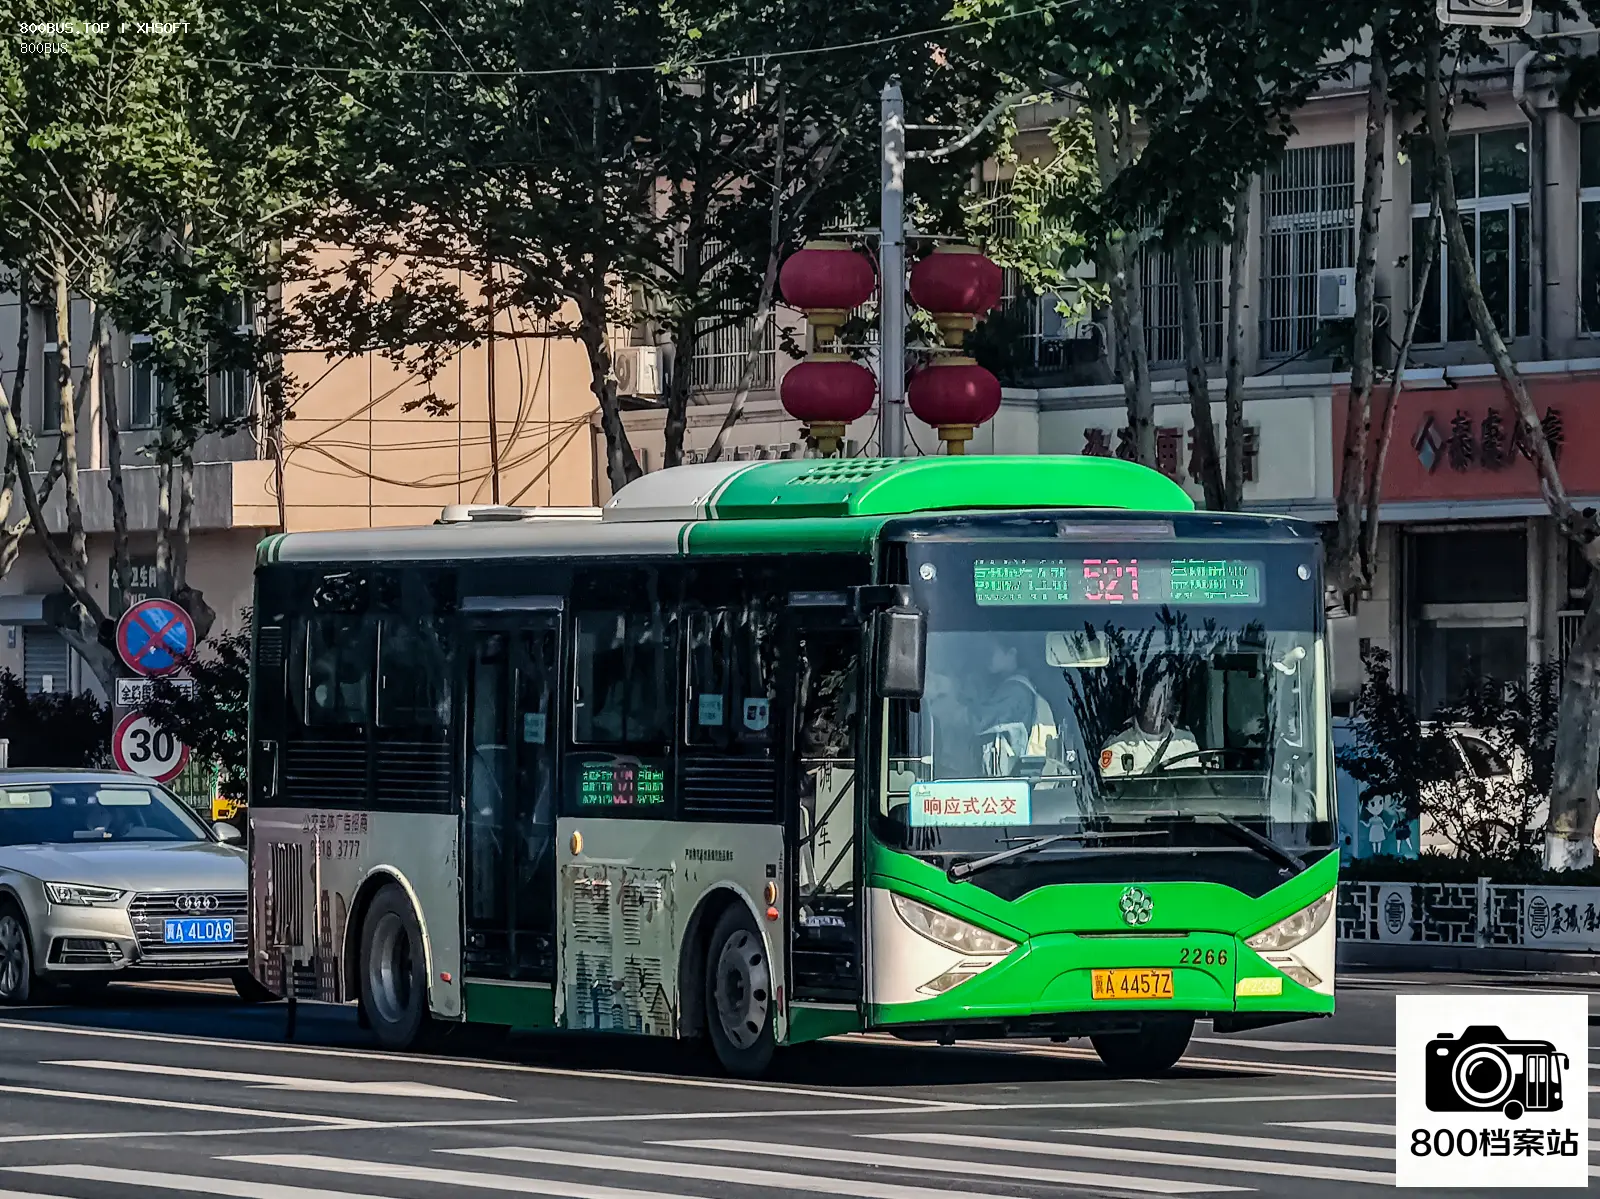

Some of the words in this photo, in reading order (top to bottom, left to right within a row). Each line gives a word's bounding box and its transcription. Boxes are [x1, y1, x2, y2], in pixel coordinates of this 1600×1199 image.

[111, 565, 157, 588] 公卫生间
[1083, 558, 1139, 600] 521
[129, 728, 175, 763] 30
[923, 796, 1017, 816] 响应式公交
[337, 839, 360, 858] 3777
[1179, 948, 1228, 965] 2266
